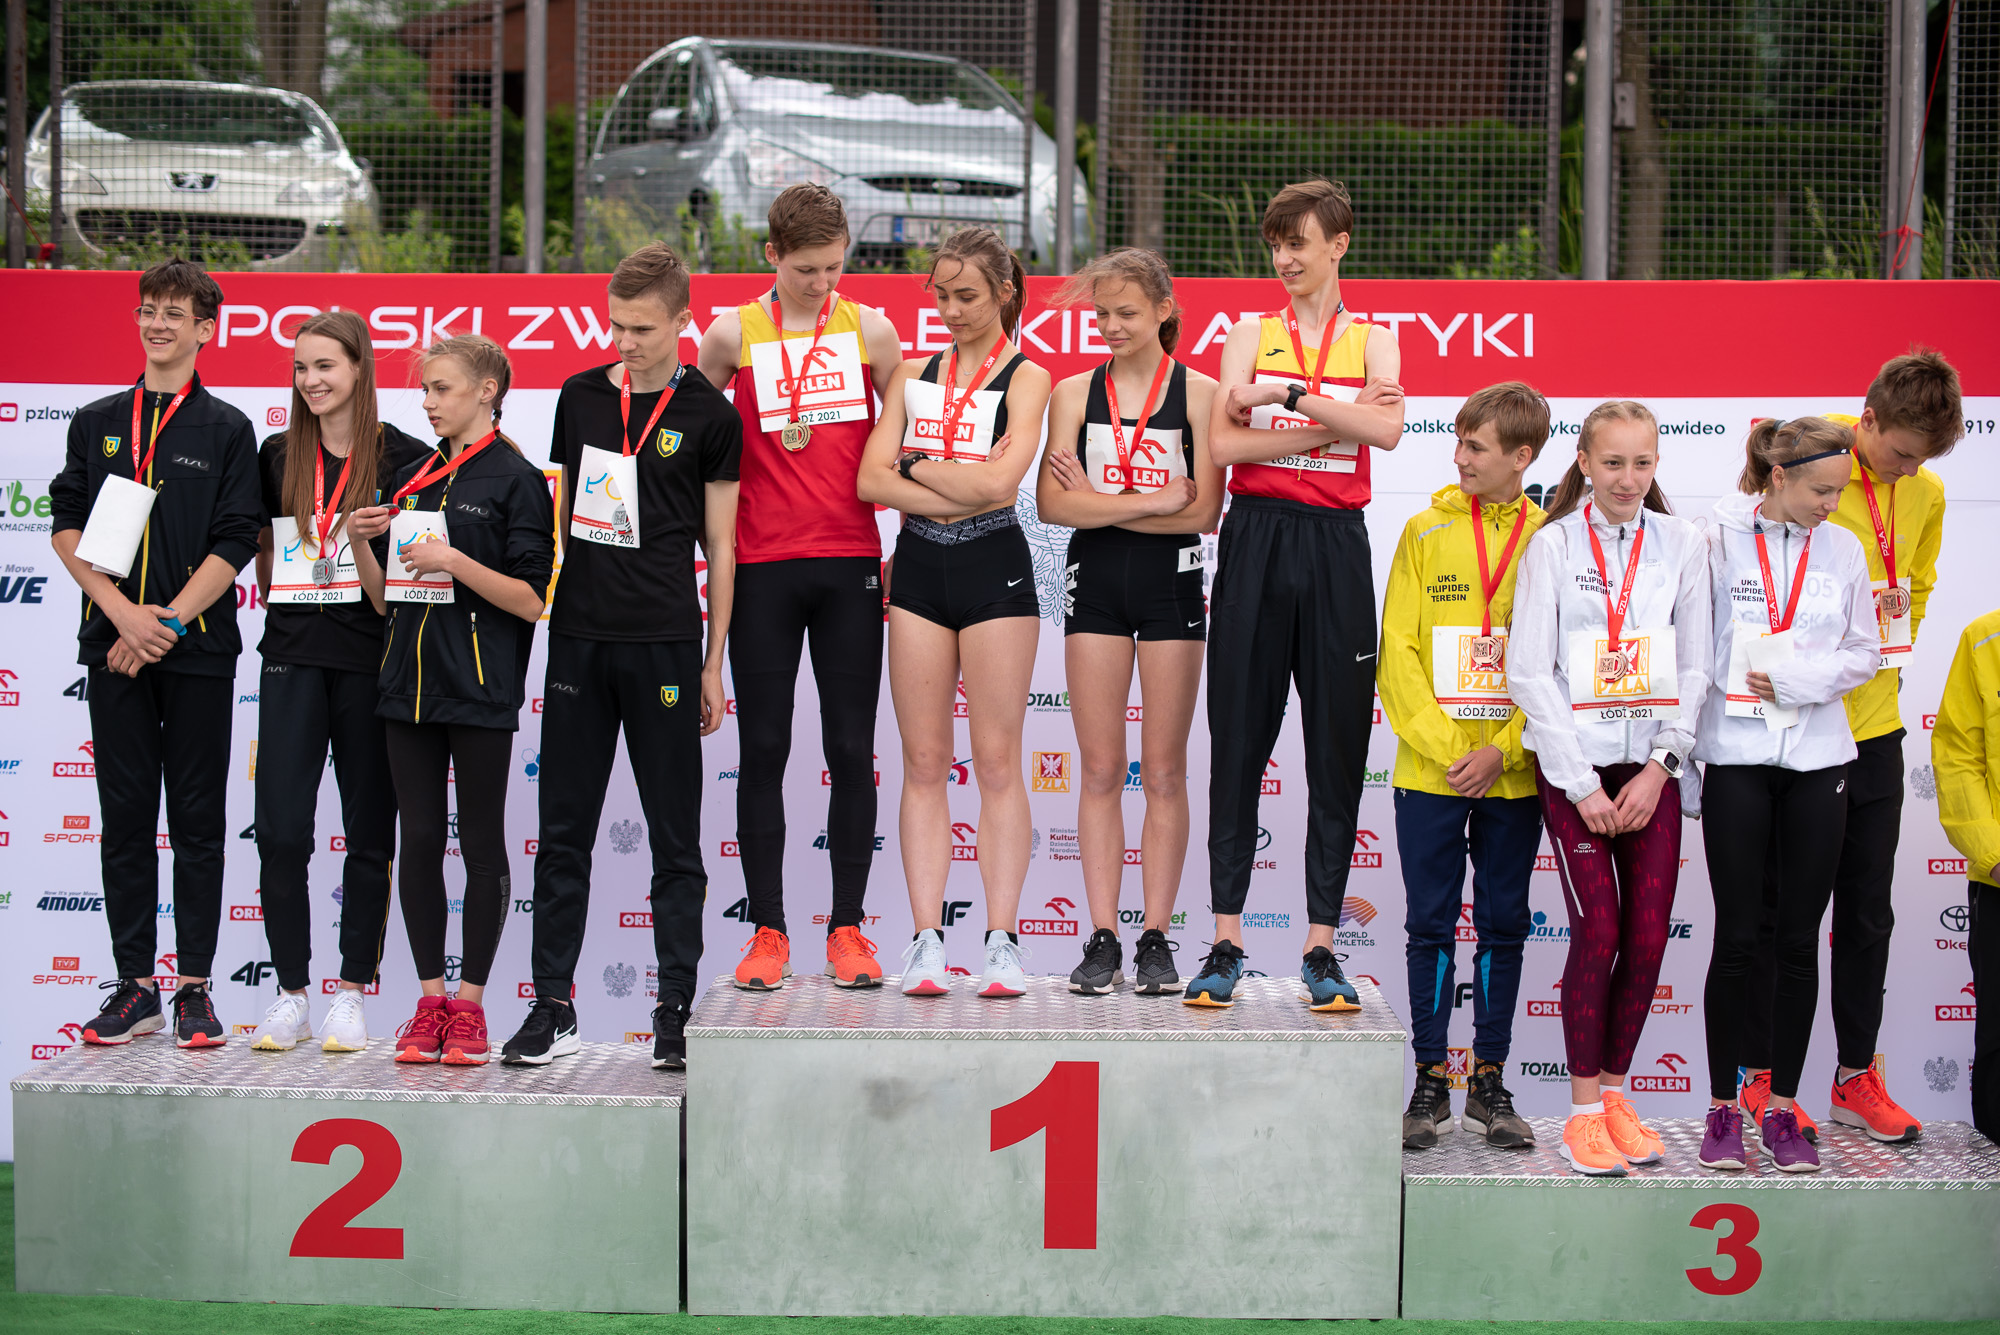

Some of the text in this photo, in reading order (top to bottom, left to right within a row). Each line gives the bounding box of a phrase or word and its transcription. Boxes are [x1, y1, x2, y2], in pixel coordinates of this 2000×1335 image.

[218, 304, 483, 350] POSKI
[817, 410, 841, 422] 2021
[943, 403, 952, 425] PZLA
[1658, 420, 1725, 436] awideo
[1115, 430, 1126, 456] PZLA
[1303, 458, 1328, 470] 2021
[589, 528, 635, 545] ŁÓDŹ 202
[1878, 531, 1890, 556] PZLA
[5, 564, 35, 574] Move
[1437, 574, 1457, 583] UKS
[404, 587, 448, 601] ŁÓDŹ 2021
[1426, 584, 1470, 593] FILIPIDES
[292, 590, 343, 601] ŁÓDŹ 2021
[1431, 594, 1467, 603] TERESIN
[1732, 594, 1765, 603] TERESIN
[1618, 590, 1630, 615] PZLA
[1769, 601, 1779, 628] PZLA
[1460, 673, 1508, 690] PZLA
[1596, 677, 1647, 695] PZLA
[1458, 704, 1511, 718] ŁÓDŹ 2021
[1629, 708, 1653, 718] 2021
[1034, 779, 1067, 790] PZLA
[66, 818, 87, 827] TVP
[1053, 853, 1081, 861] Sportu
[1533, 858, 1558, 869] ORL
[36, 896, 105, 911] 4MOVE
[232, 908, 264, 919] ORL
[622, 914, 653, 925] ORL
[1242, 913, 1290, 921] EUROPEAN
[1022, 922, 1075, 934] ORLEN
[1242, 920, 1290, 928] ATHLETICS
[1337, 931, 1368, 939] WORLD
[32, 975, 98, 985] SPORT
[1530, 1002, 1562, 1014] ORL
[1651, 1005, 1693, 1014] ORT
[1939, 1007, 1977, 1019] ORLE
[1634, 1078, 1687, 1090] ORLEN
[989, 1060, 1100, 1250] 1
[288, 1117, 405, 1260] 2
[1685, 1202, 1763, 1297] 3
